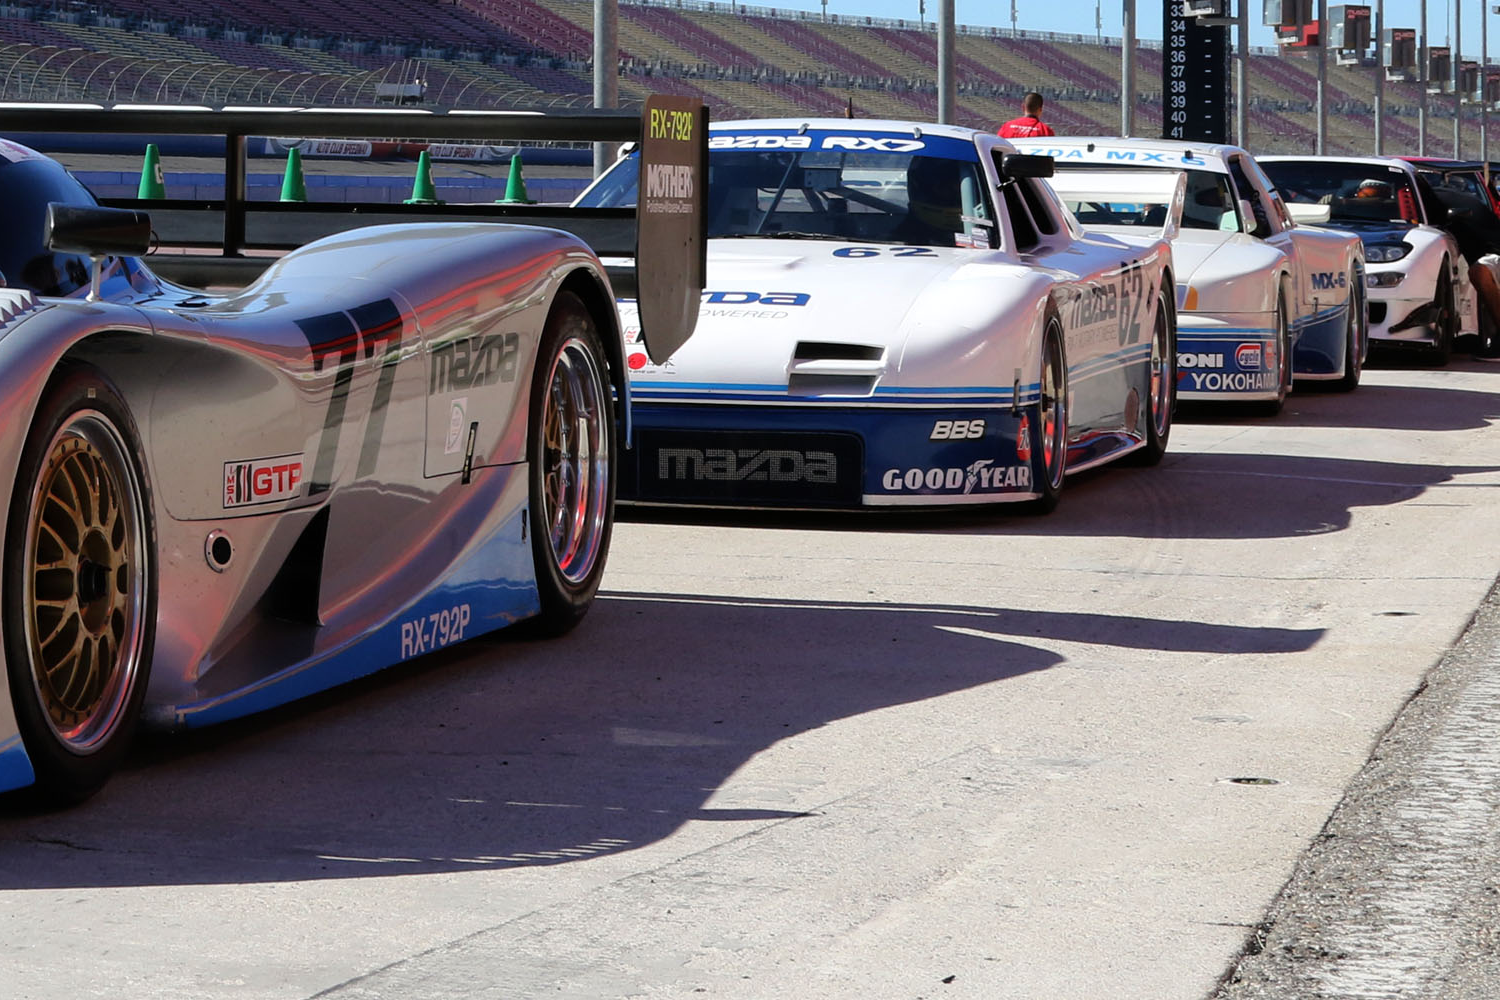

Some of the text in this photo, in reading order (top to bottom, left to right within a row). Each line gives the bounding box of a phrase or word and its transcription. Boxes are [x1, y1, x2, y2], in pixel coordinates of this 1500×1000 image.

[1170, 20, 1185, 32] 34
[1170, 35, 1185, 47] 35
[1170, 50, 1185, 62] 36
[1170, 65, 1185, 77] 37
[1170, 81, 1185, 93] 38
[1170, 96, 1185, 108] 39
[1170, 111, 1185, 123] 40
[1170, 127, 1183, 139] 41
[708, 136, 926, 152] azda RX7
[1106, 151, 1206, 166] MX-6
[832, 247, 940, 258] 62
[1311, 272, 1346, 290] MX-6
[1119, 259, 1143, 346] 62
[700, 309, 789, 319] OWERED
[1191, 372, 1277, 391] YOKOHAMA
[292, 297, 403, 497] 77
[929, 419, 987, 442] BBS
[253, 462, 302, 496] GTP
[401, 604, 471, 660] RX-792P
